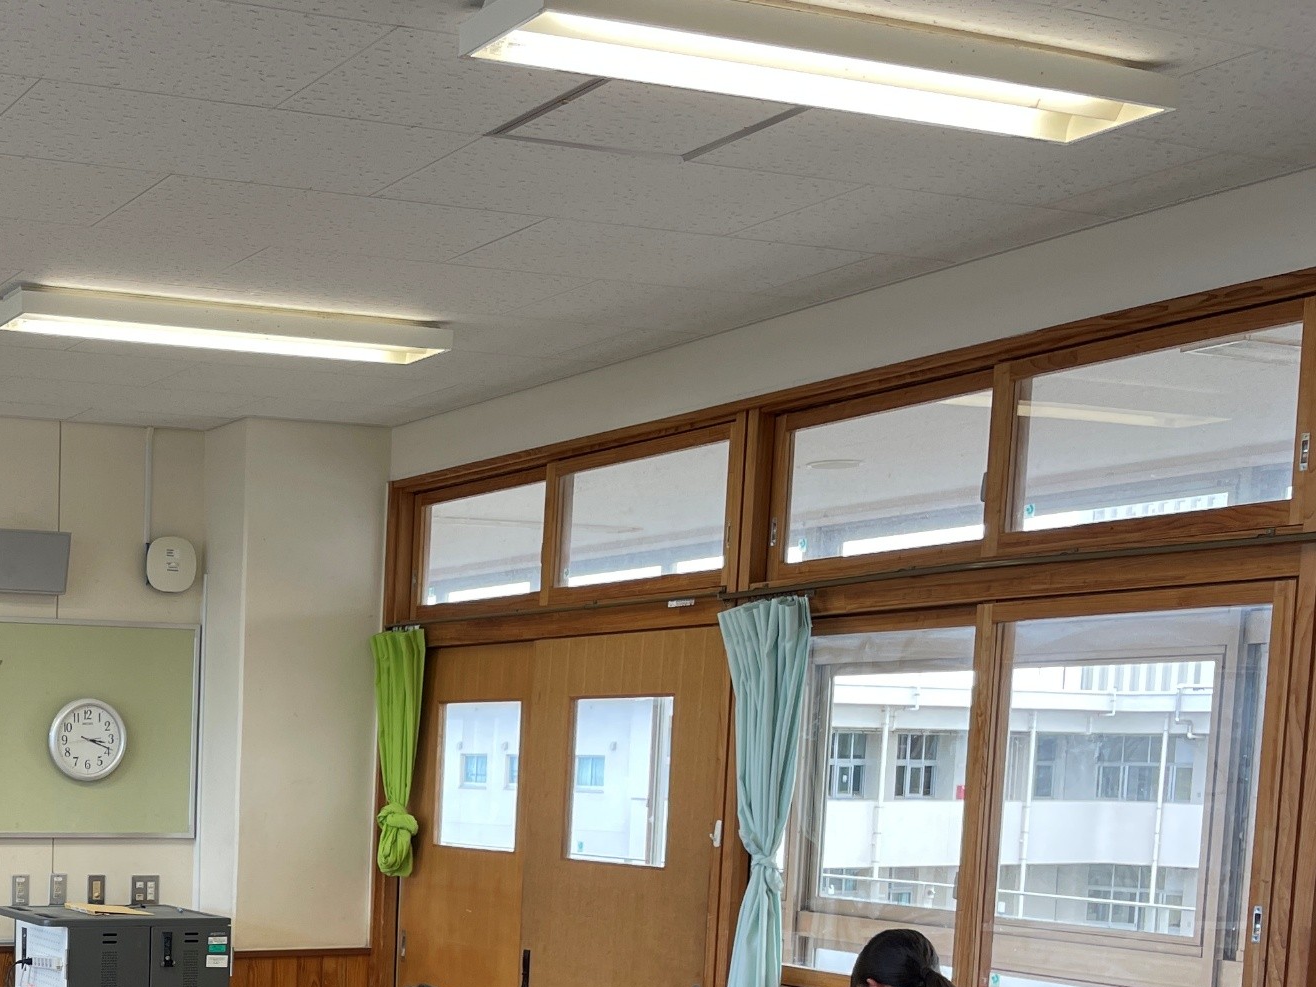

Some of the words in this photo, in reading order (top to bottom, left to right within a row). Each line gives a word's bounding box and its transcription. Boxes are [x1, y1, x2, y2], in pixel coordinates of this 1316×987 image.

[73, 712, 80, 723] 11
[84, 709, 92, 720] 12
[63, 722, 73, 733] 10
[104, 721, 111, 732] 2
[61, 735, 68, 745] 9
[108, 733, 114, 744] 3
[64, 747, 71, 757] 8
[103, 747, 111, 756] 4
[72, 756, 79, 766] 7
[84, 760, 91, 769] 6
[97, 756, 103, 766] 5
